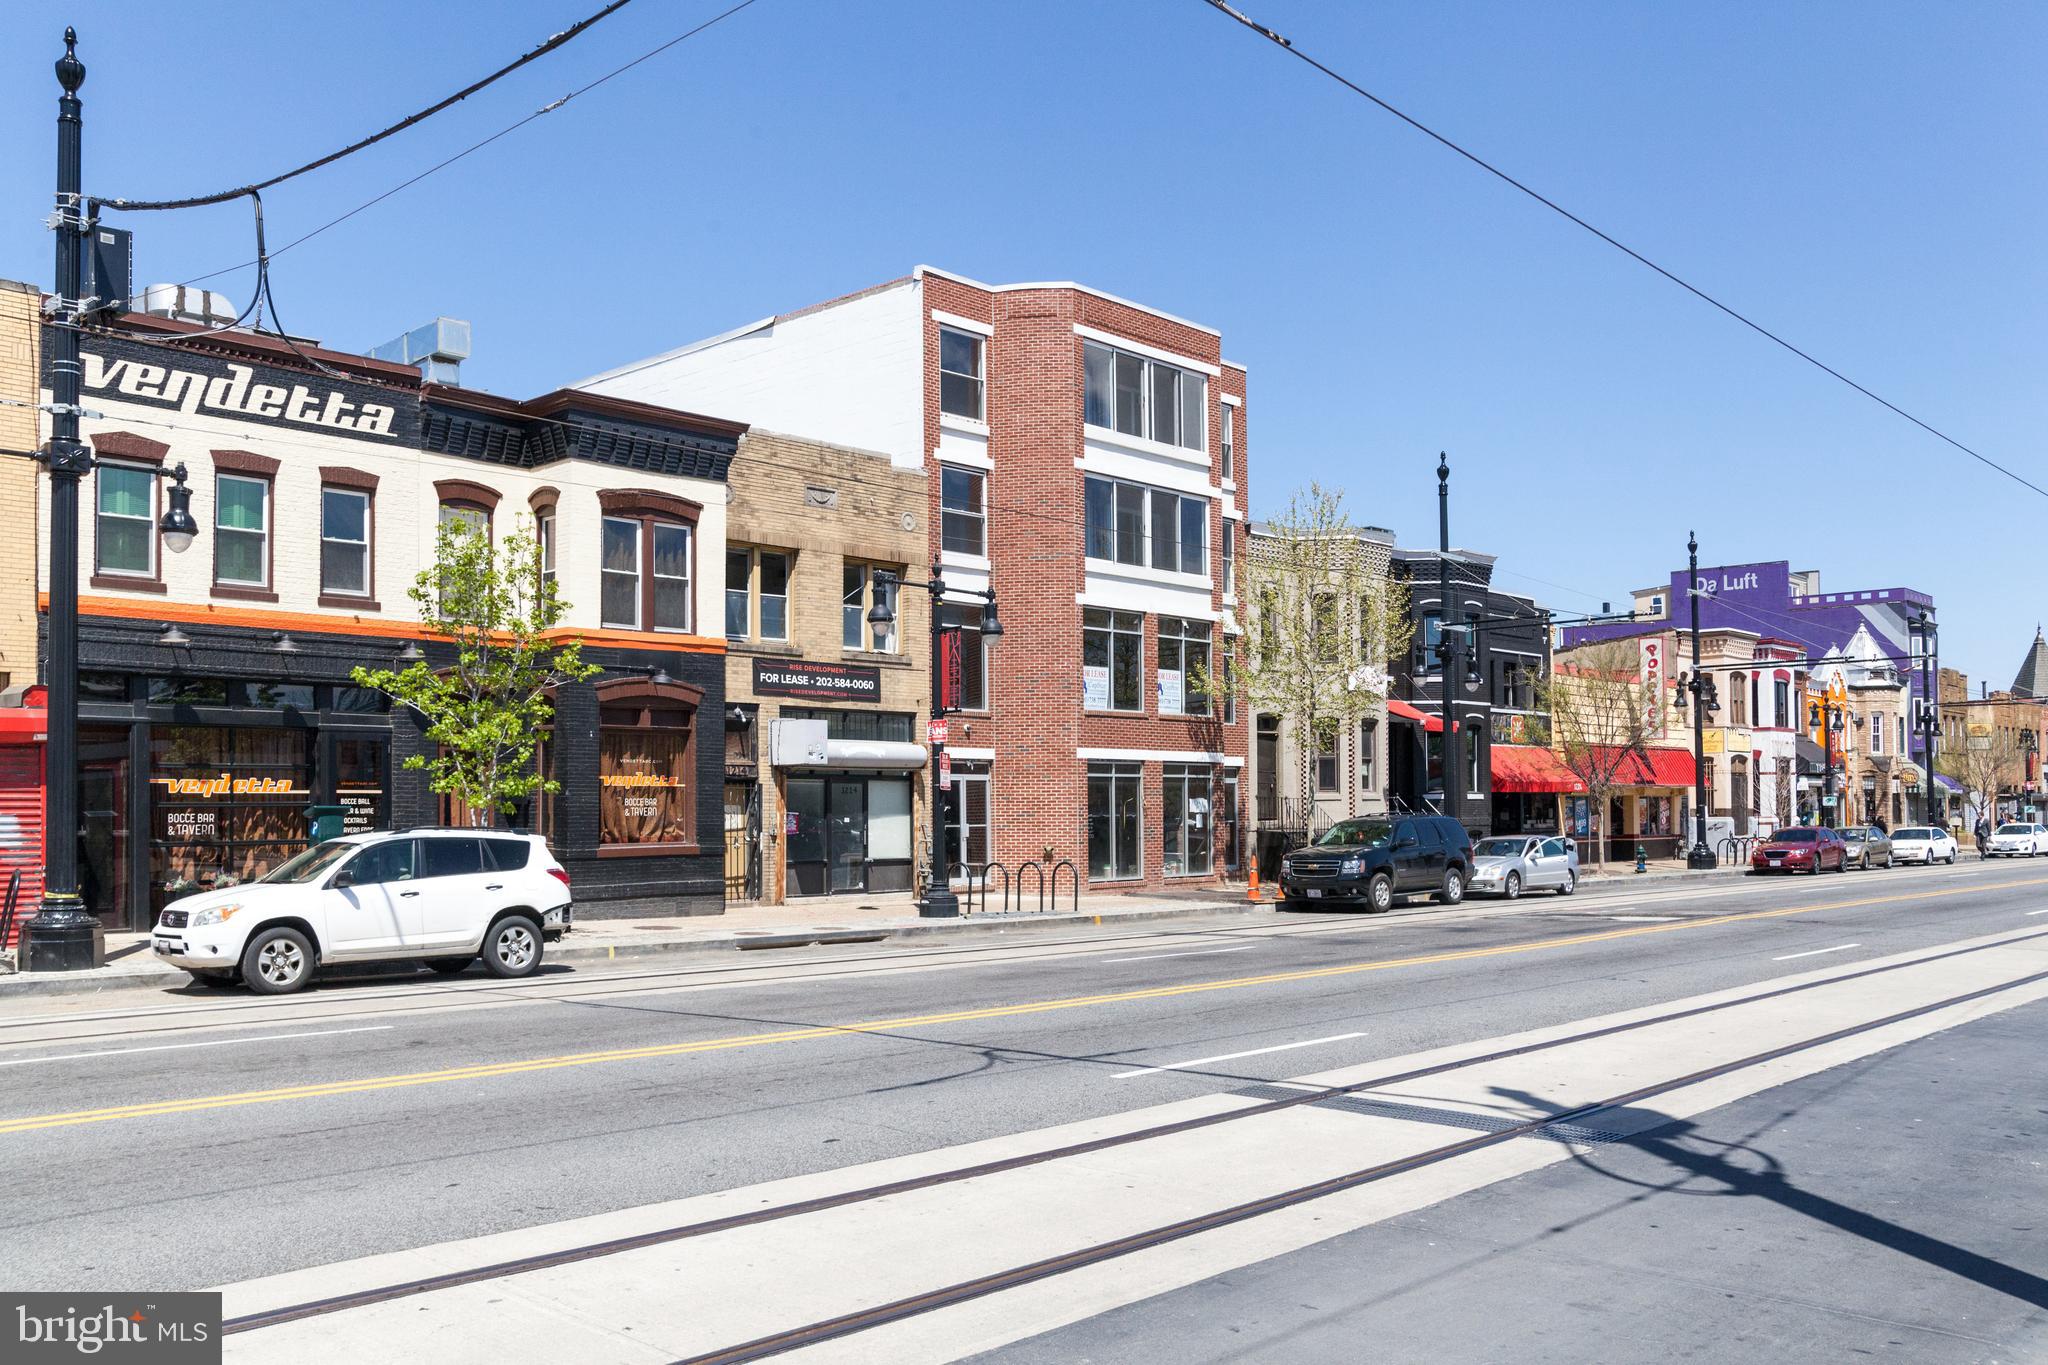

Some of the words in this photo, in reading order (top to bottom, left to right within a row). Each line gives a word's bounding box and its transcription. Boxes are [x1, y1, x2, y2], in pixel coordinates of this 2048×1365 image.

[80, 352, 398, 437] vendetta
[1696, 577, 1717, 592] Da
[1723, 573, 1758, 591] Luft
[803, 665, 847, 674] DEVELOPMENT
[760, 672, 779, 683] FOR
[781, 674, 808, 685] LEASE
[816, 676, 874, 690] 202-584-0060
[790, 688, 848, 697] RISEDEVELOPMENT.COM
[148, 773, 309, 797] vendetta
[624, 798, 644, 806] BOCCE
[644, 798, 657, 806] BAR
[624, 808, 630, 817] &
[630, 807, 657, 817] TAVERN
[168, 813, 195, 823] BOCCE
[197, 813, 215, 823] BAR
[168, 825, 175, 836] &
[177, 824, 215, 836] TAVERN
[343, 826, 361, 834] AVERN
